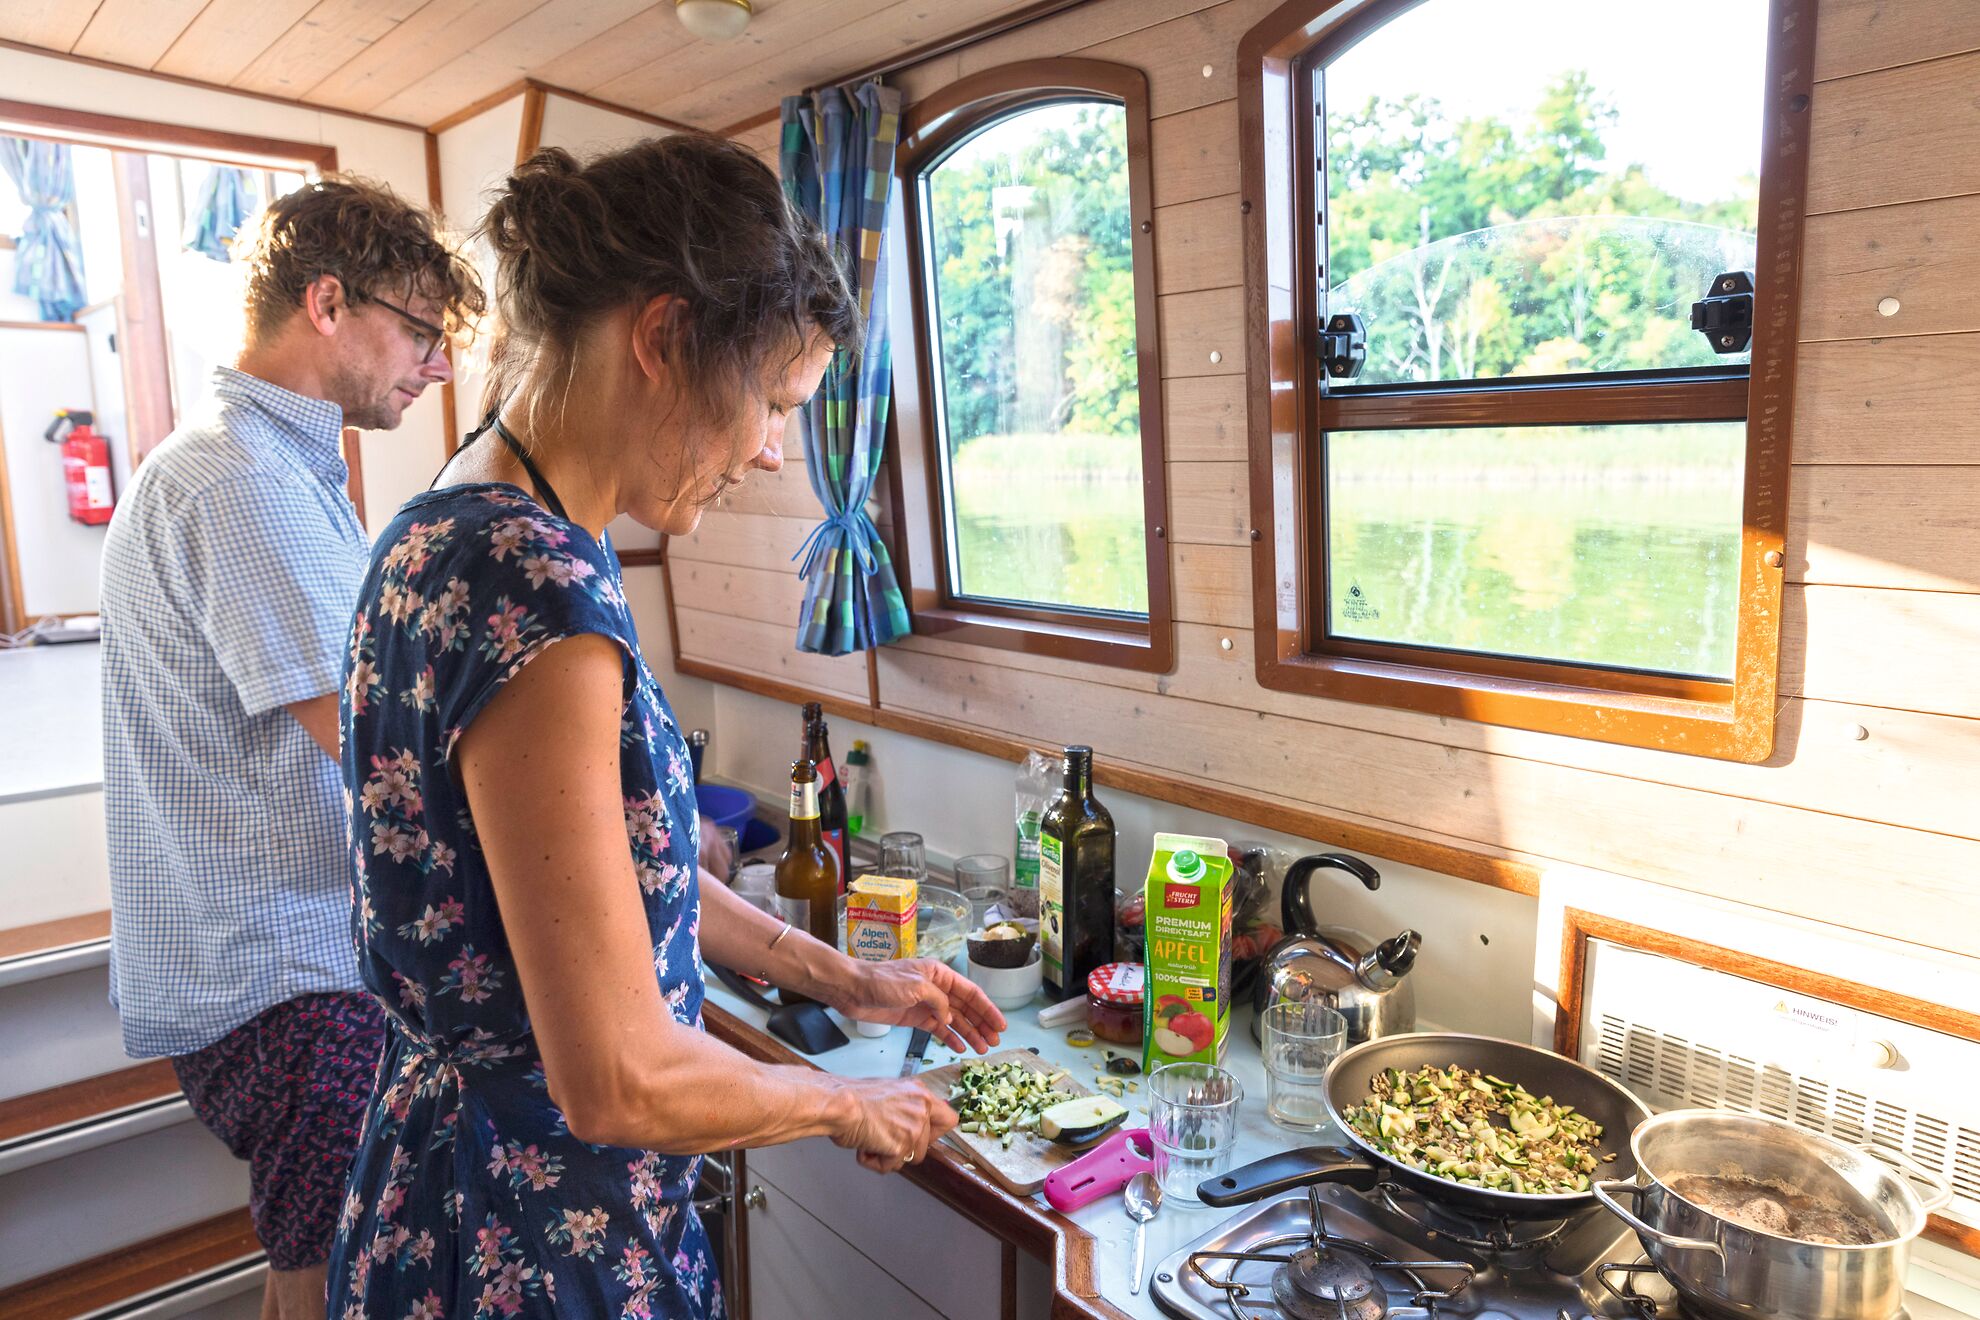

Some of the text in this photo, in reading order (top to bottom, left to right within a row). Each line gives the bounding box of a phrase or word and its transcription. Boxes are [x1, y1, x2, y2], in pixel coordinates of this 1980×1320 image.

[1171, 891, 1198, 899] FRUCHT
[1174, 897, 1196, 905] STERN
[1155, 916, 1212, 931] PREMIUM
[862, 928, 889, 938] Alpen
[1155, 925, 1211, 939] DIREKTSAFT
[857, 939, 892, 950] JodSalz
[1154, 938, 1209, 964] APFEL
[1155, 973, 1179, 984] 100%
[1792, 1008, 1838, 1026] HINWEIS!
